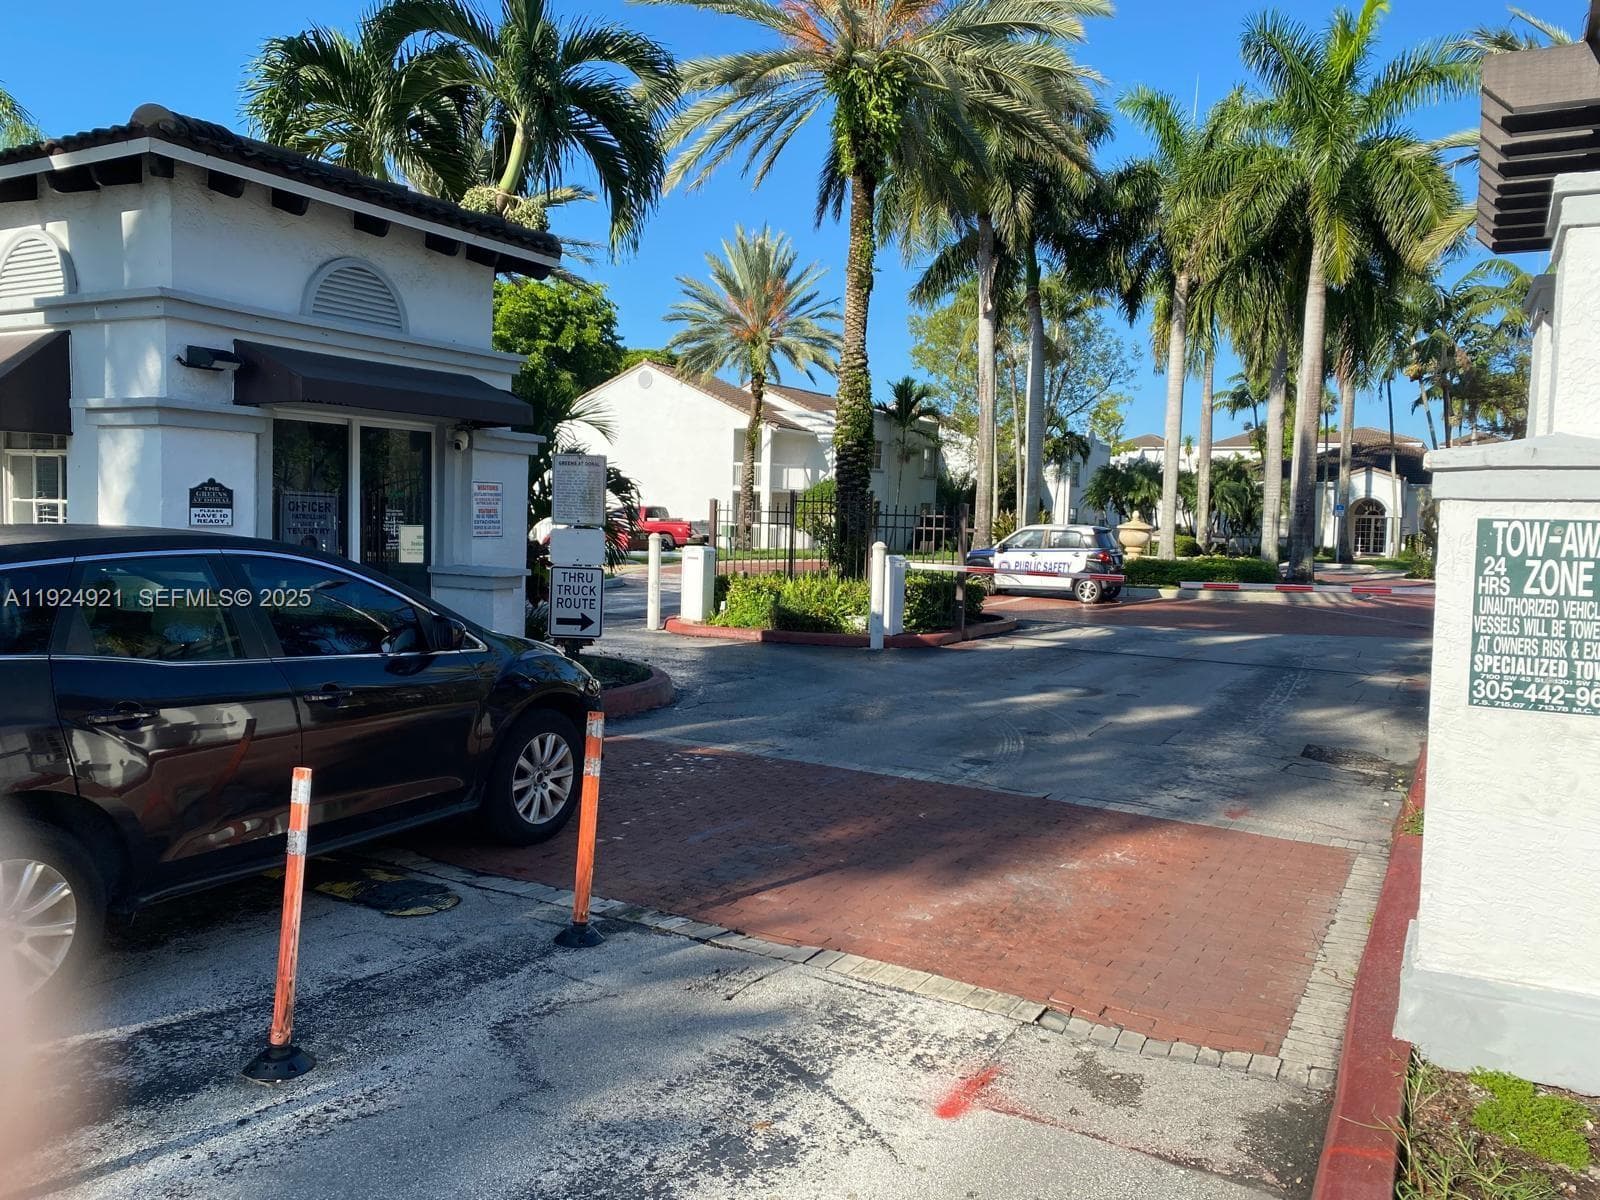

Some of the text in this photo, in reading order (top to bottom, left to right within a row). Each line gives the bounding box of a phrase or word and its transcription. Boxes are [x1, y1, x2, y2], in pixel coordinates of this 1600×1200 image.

[288, 501, 331, 512] OFFICER
[1493, 520, 1600, 559] TOW-AW
[1014, 561, 1072, 574] PUBLIC SAFETY
[1484, 556, 1507, 576] 24
[561, 571, 594, 583] THRU
[1478, 576, 1511, 596] HRS
[1523, 559, 1595, 597] ZONE
[557, 584, 597, 597] TRUCK
[556, 597, 597, 610] ROUTE
[1480, 596, 1560, 618] UNAUTHORIZED
[1474, 616, 1520, 636] VESSELS
[1524, 618, 1548, 637] WILL
[1552, 619, 1566, 638] BE
[1477, 635, 1490, 653] AT
[1493, 636, 1539, 657] OWNERS
[1542, 639, 1567, 658] RISK
[1571, 640, 1579, 659] &
[1473, 653, 1569, 679] SPECIALIZED
[1480, 673, 1501, 681] 7100
[1494, 700, 1526, 709] 715.07
